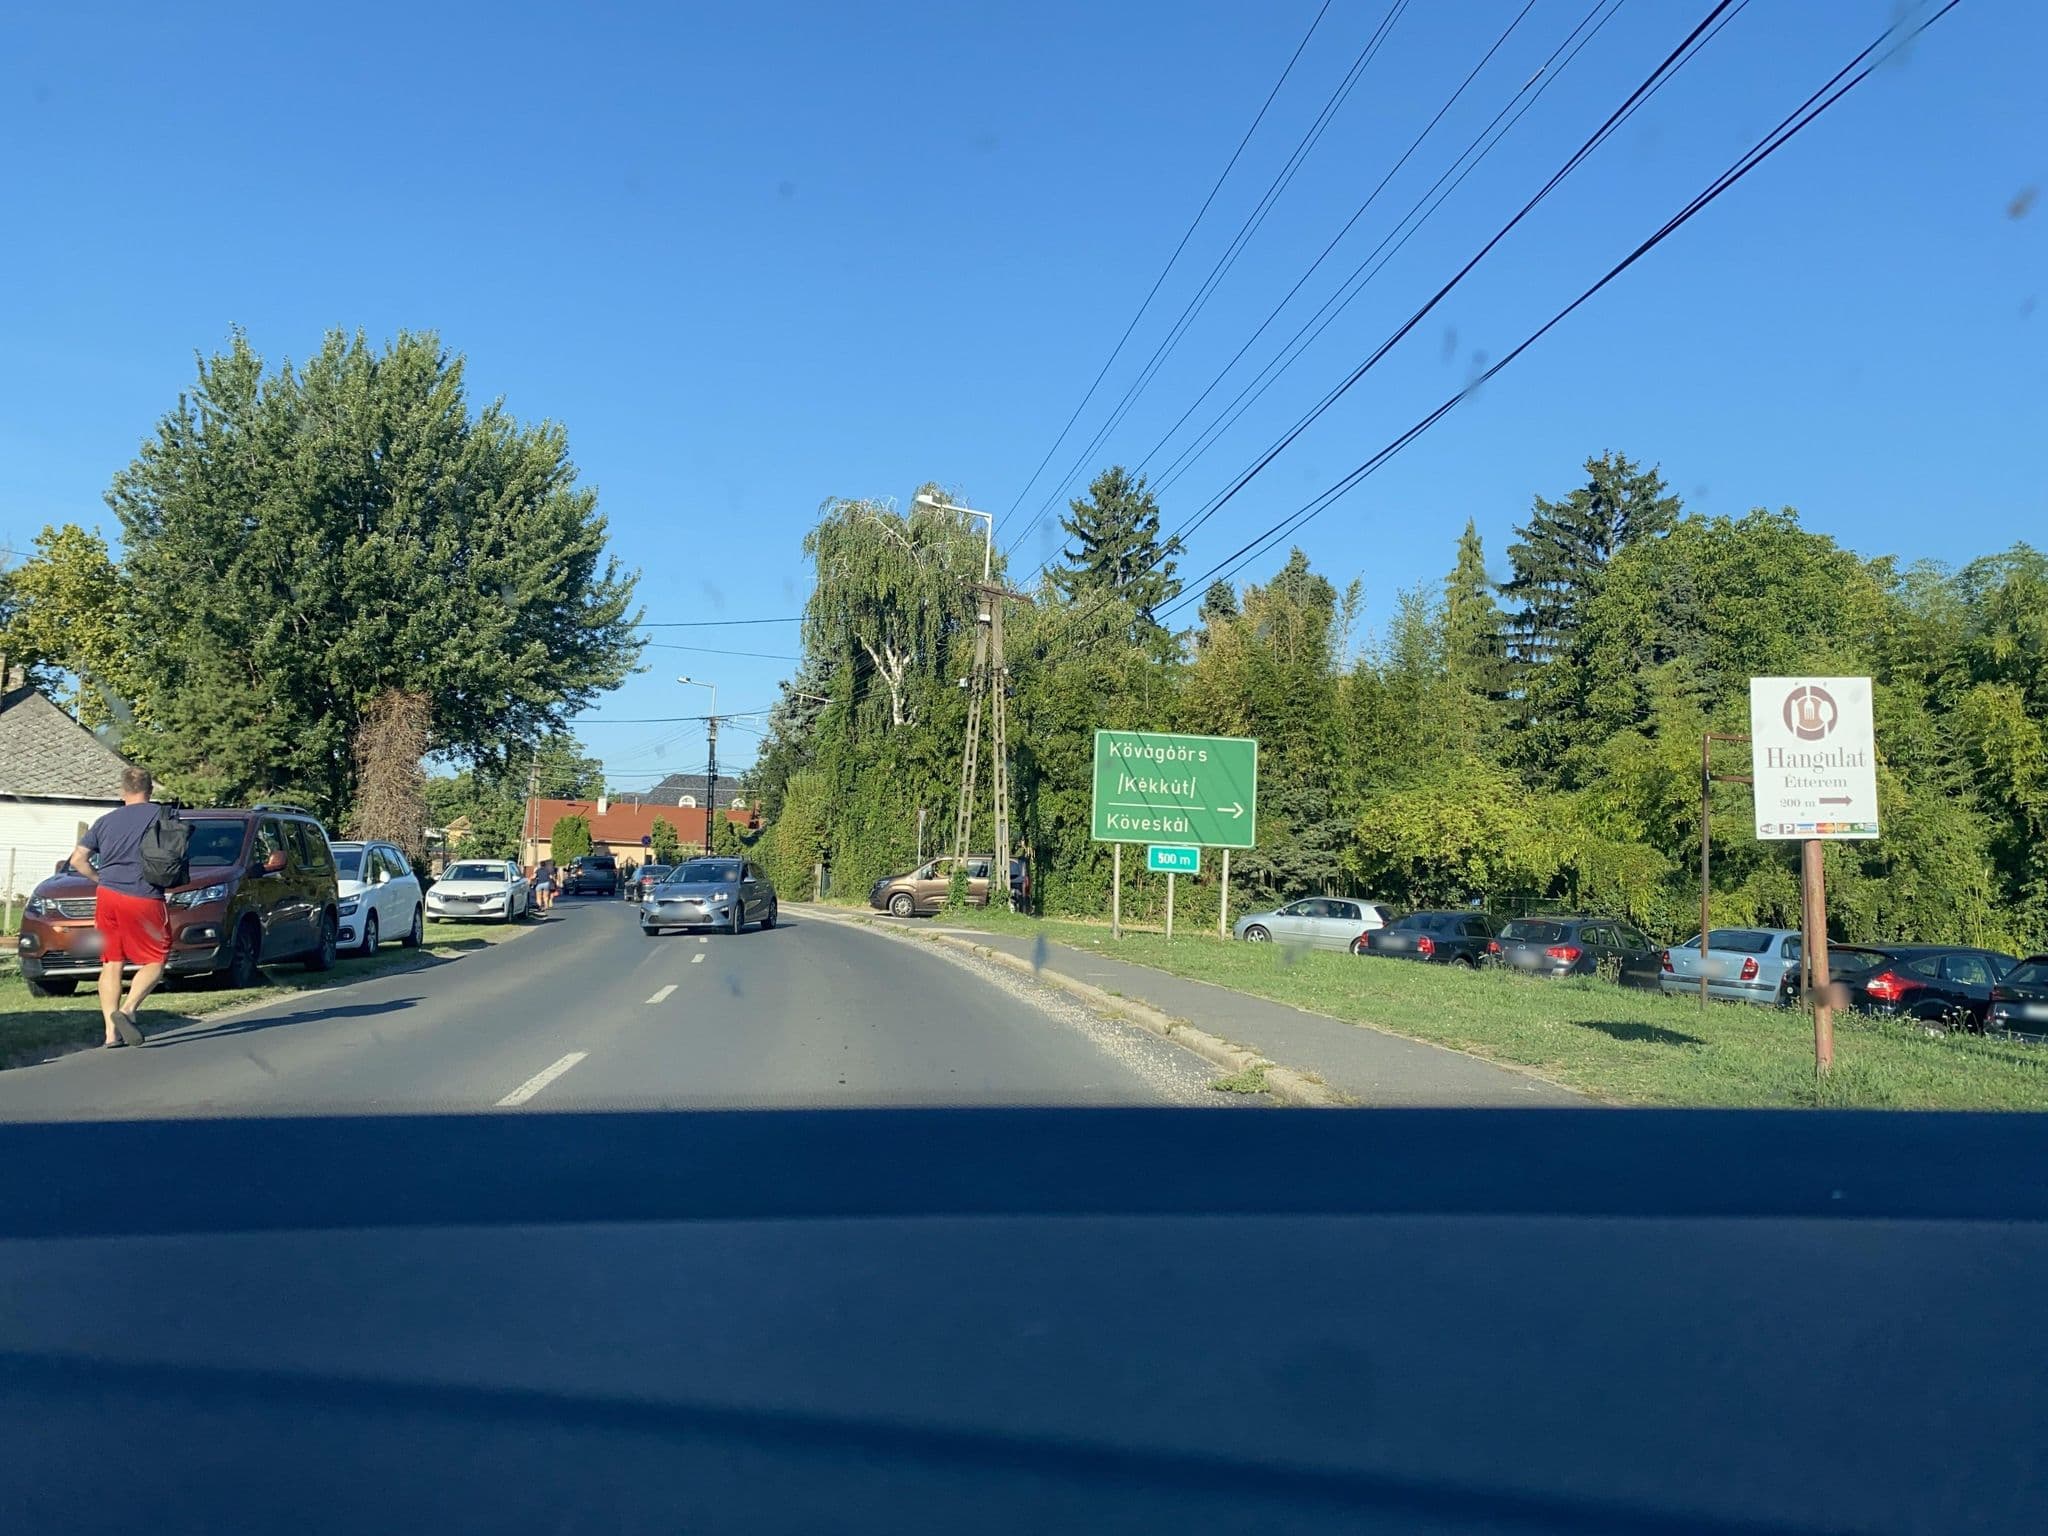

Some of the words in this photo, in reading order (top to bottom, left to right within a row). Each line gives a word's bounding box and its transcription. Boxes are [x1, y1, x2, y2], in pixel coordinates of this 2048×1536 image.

[1767, 747, 1865, 774] Hangulat
[1784, 774, 1847, 788] Étterem
[1780, 798, 1801, 808] 200
[1804, 800, 1816, 808] m
[1107, 814, 1188, 833] Köveskál
[1158, 852, 1177, 865] 500
[1179, 856, 1191, 866] m
